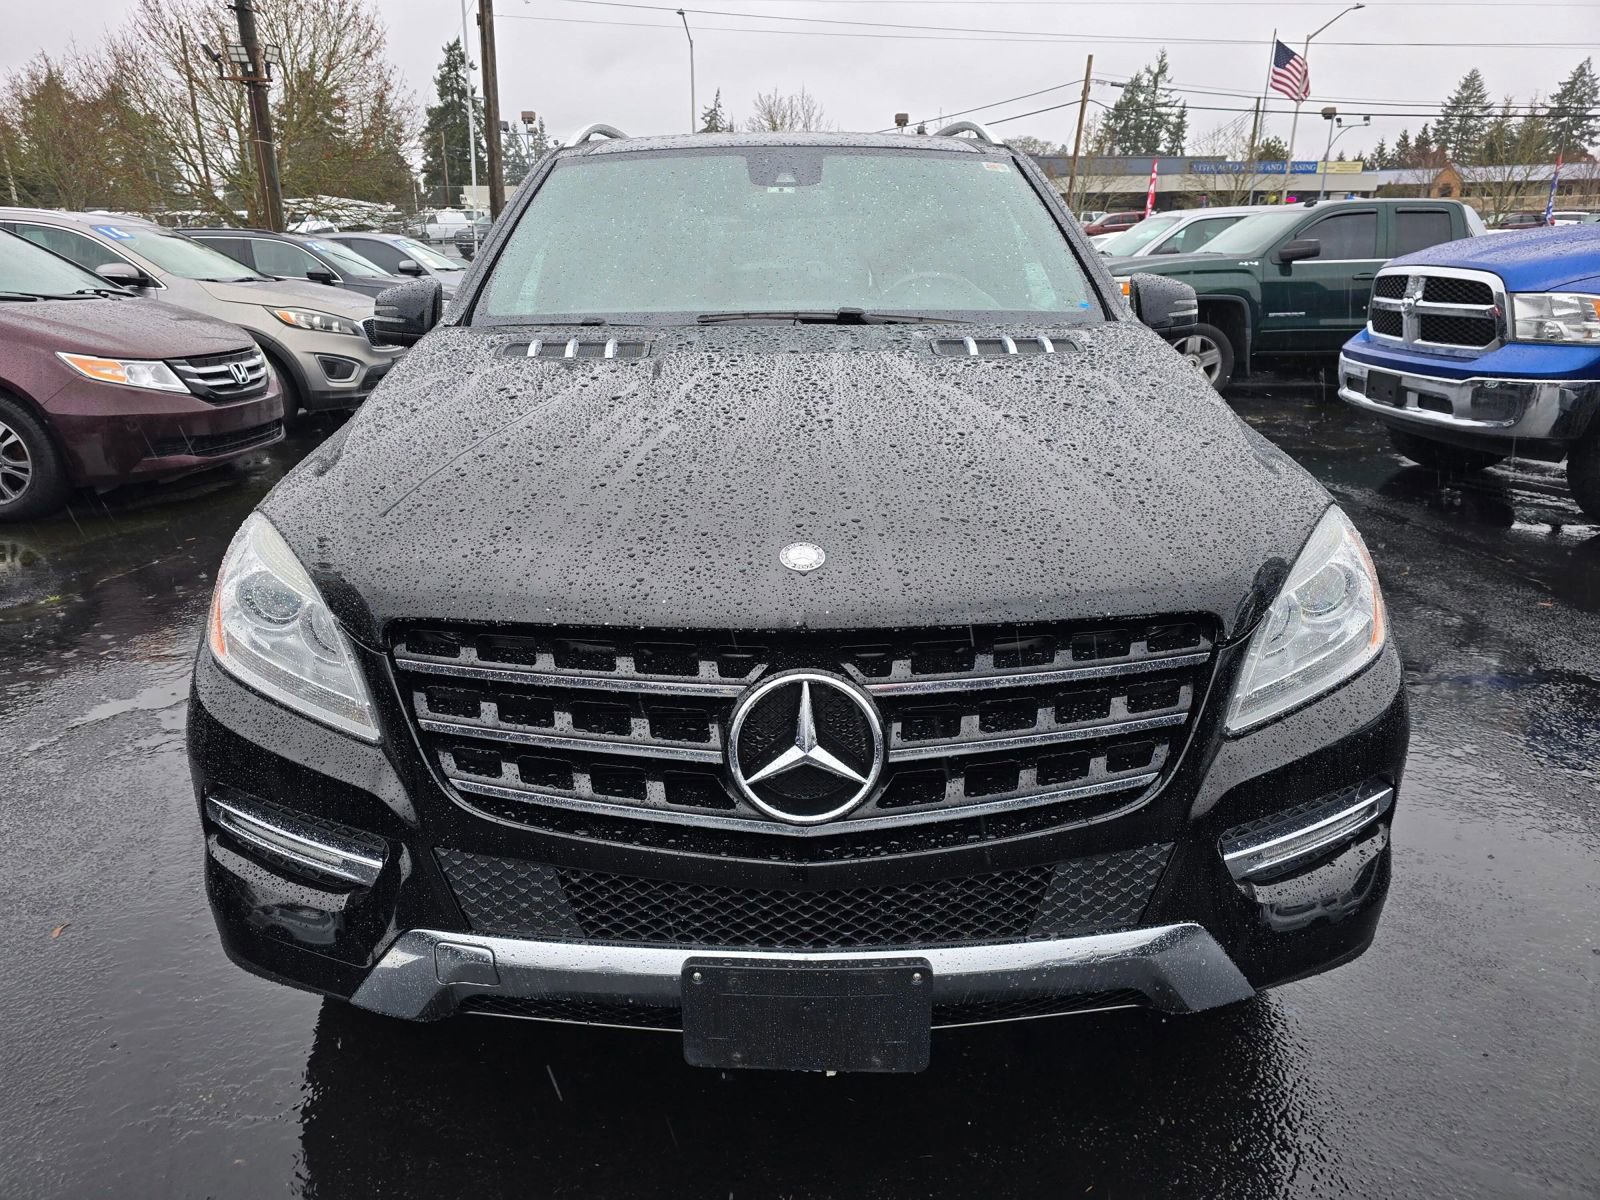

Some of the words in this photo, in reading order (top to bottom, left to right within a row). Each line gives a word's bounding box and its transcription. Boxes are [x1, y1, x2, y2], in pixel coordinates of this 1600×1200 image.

[1241, 163, 1264, 171] SES
[1265, 163, 1283, 171] AND
[1283, 162, 1317, 171] LASING
